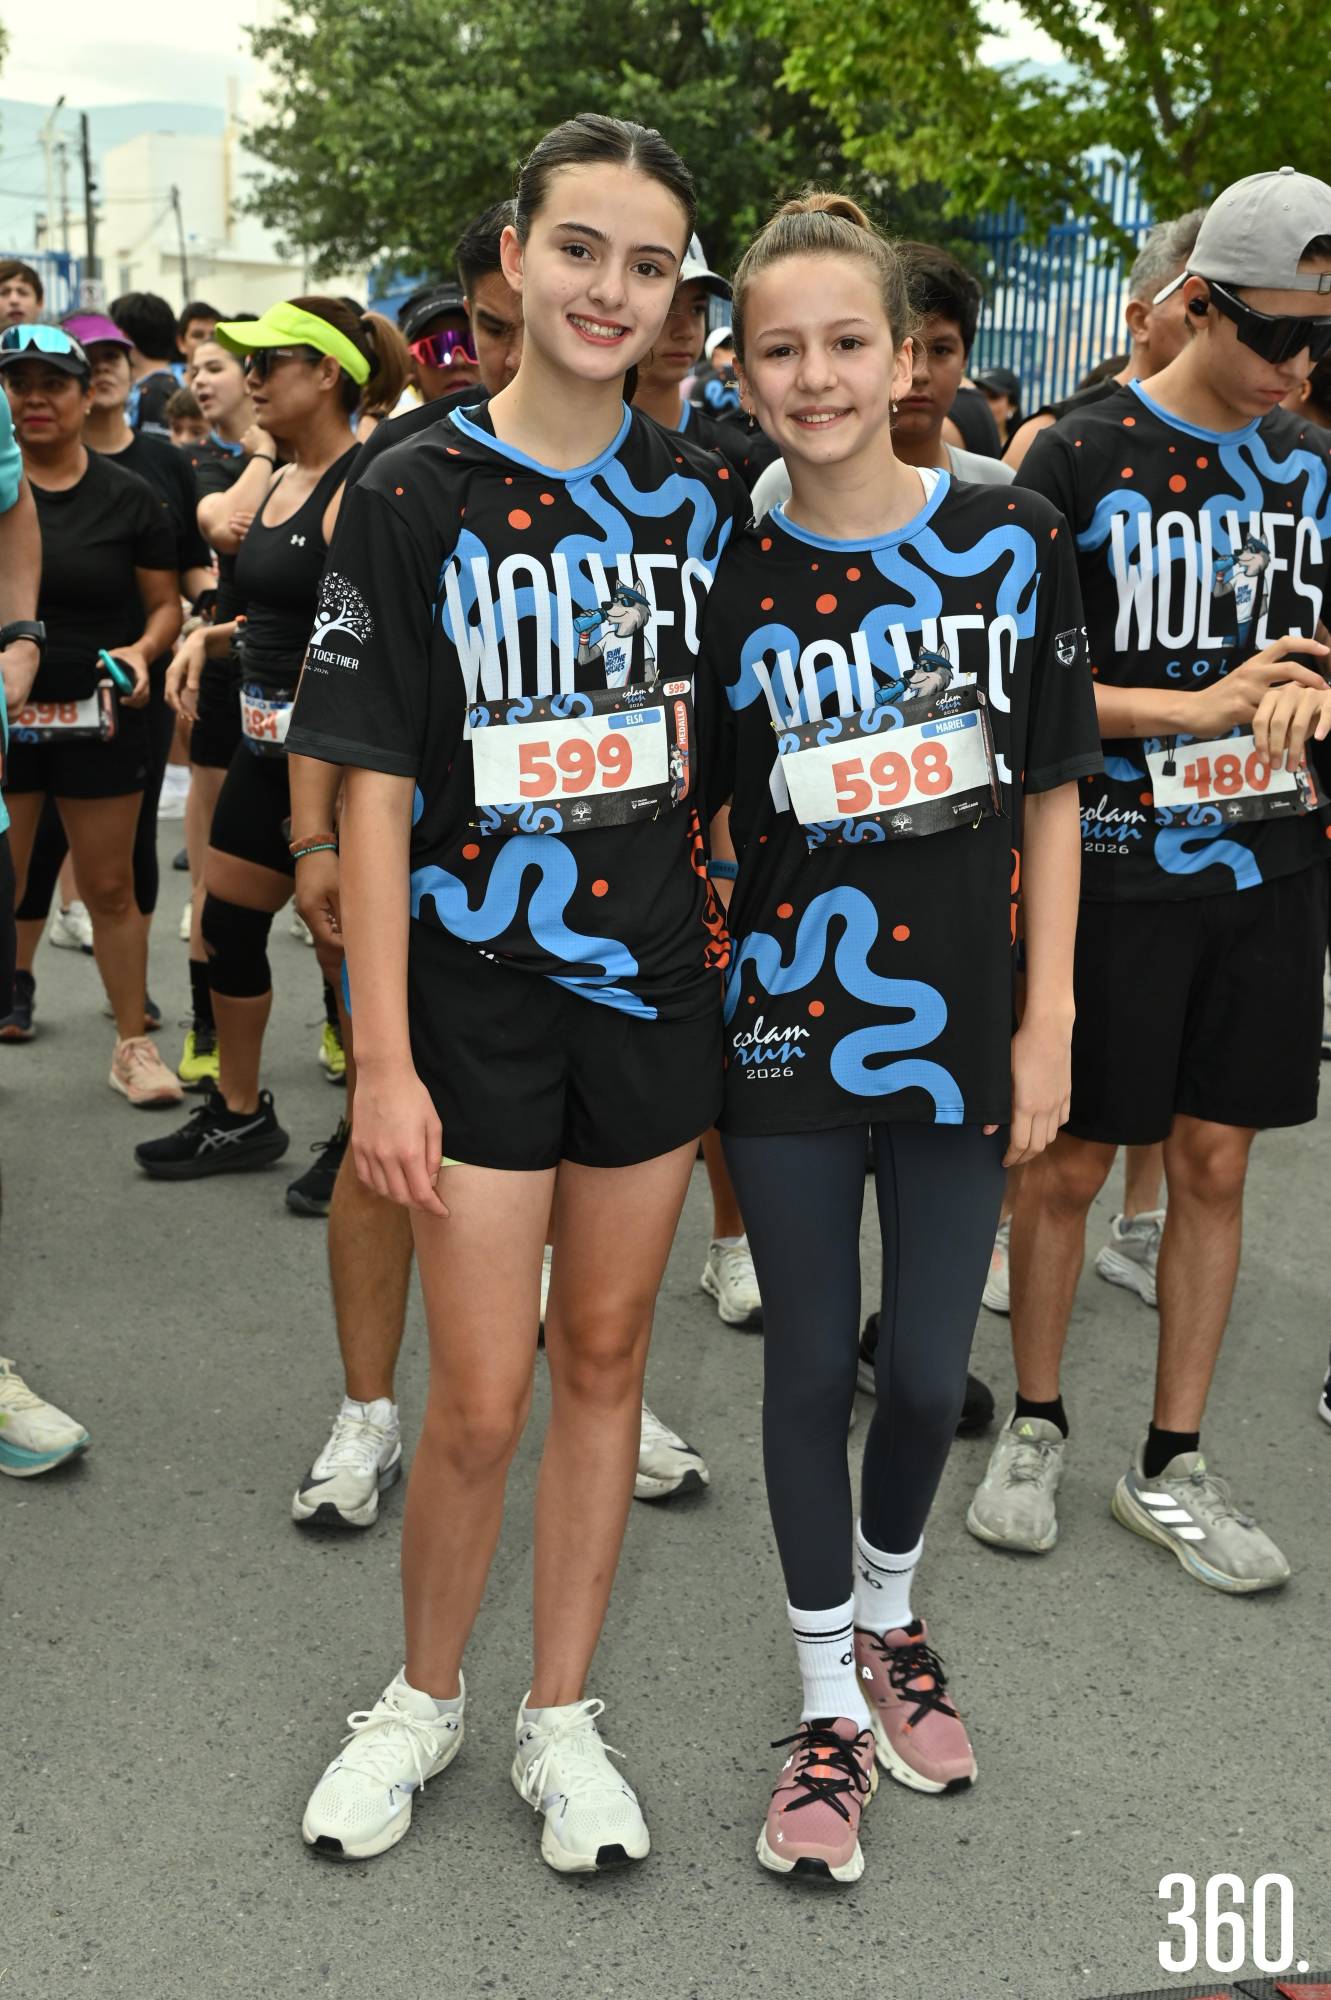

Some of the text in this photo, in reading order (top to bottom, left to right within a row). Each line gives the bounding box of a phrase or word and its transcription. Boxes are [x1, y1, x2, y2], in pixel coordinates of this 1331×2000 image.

[313, 648, 359, 670] TOGETHER
[622, 685, 647, 698] colam
[668, 683, 685, 694] 599
[935, 692, 962, 706] colam
[625, 713, 644, 725] ELSA
[943, 708, 959, 716] 2026
[676, 704, 687, 745] MEDALLA
[935, 718, 965, 734] MARIEL
[518, 733, 633, 798] 599
[831, 741, 953, 814] 598
[1183, 751, 1272, 800] 480
[1084, 842, 1130, 855] 2026
[733, 1015, 810, 1048] colam
[734, 1041, 806, 1066] run
[746, 1066, 794, 1080] 2026
